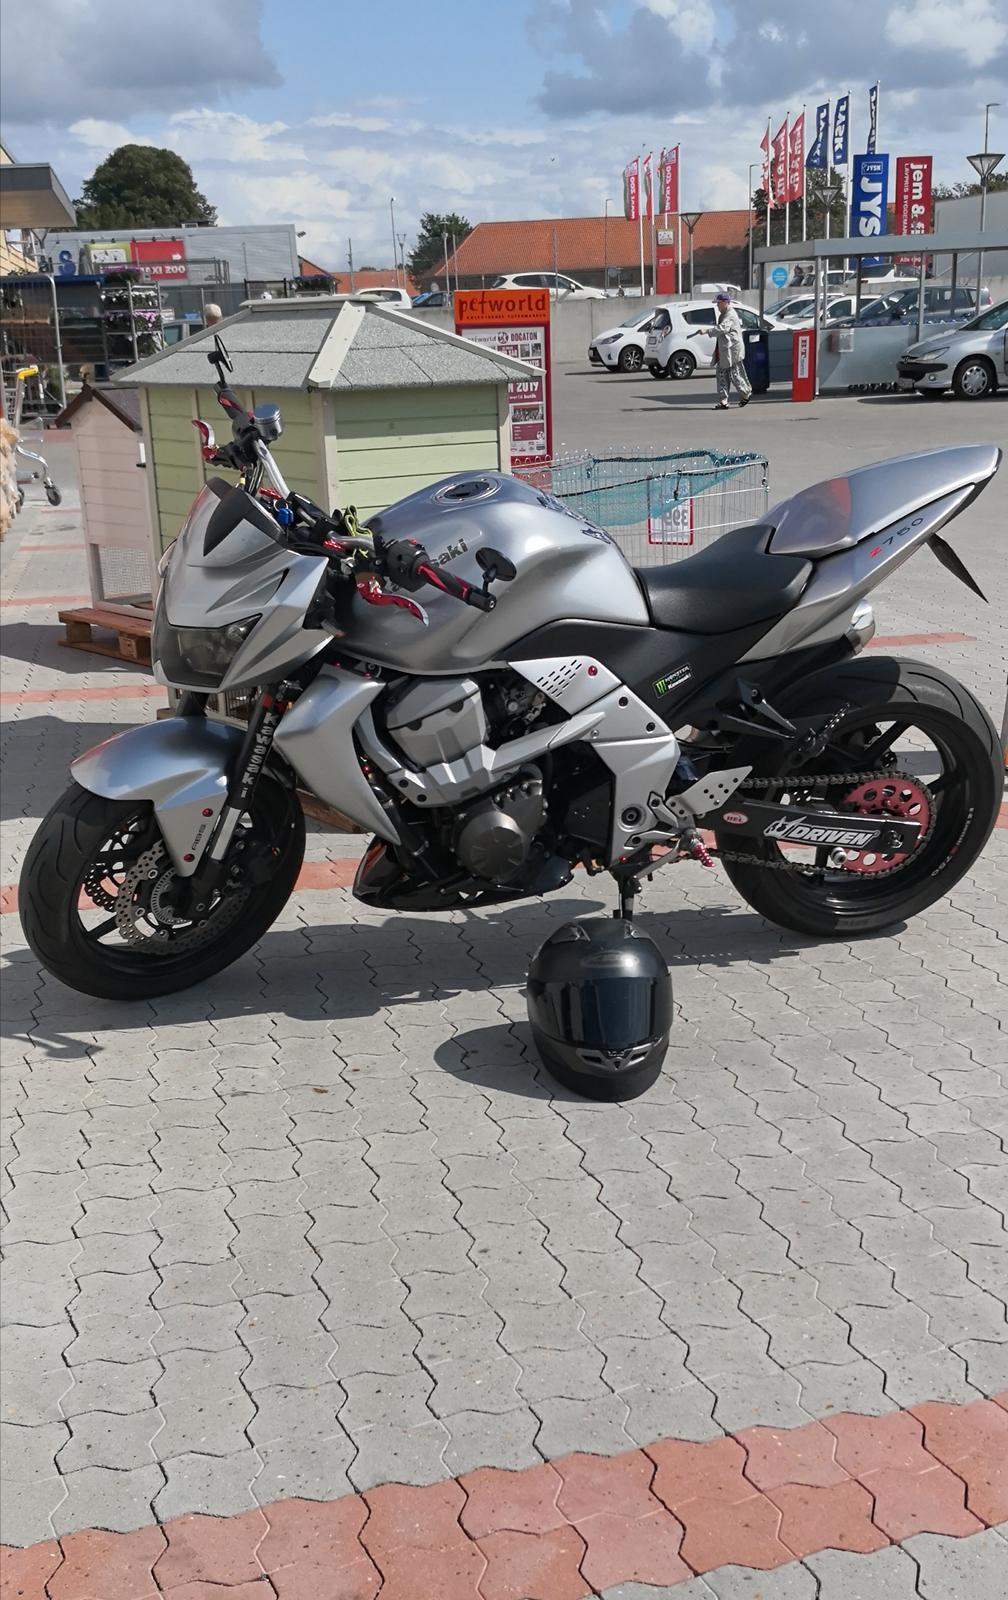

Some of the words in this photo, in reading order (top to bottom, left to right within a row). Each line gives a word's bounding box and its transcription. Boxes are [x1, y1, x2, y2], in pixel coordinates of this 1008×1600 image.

[866, 164, 882, 172] JYSK
[911, 163, 928, 200] jem
[860, 176, 883, 262] JYS
[166, 265, 186, 274] ZOO
[459, 291, 546, 321] petworld
[241, 712, 278, 798] Kawasaki
[789, 825, 873, 846] DRIVEN
